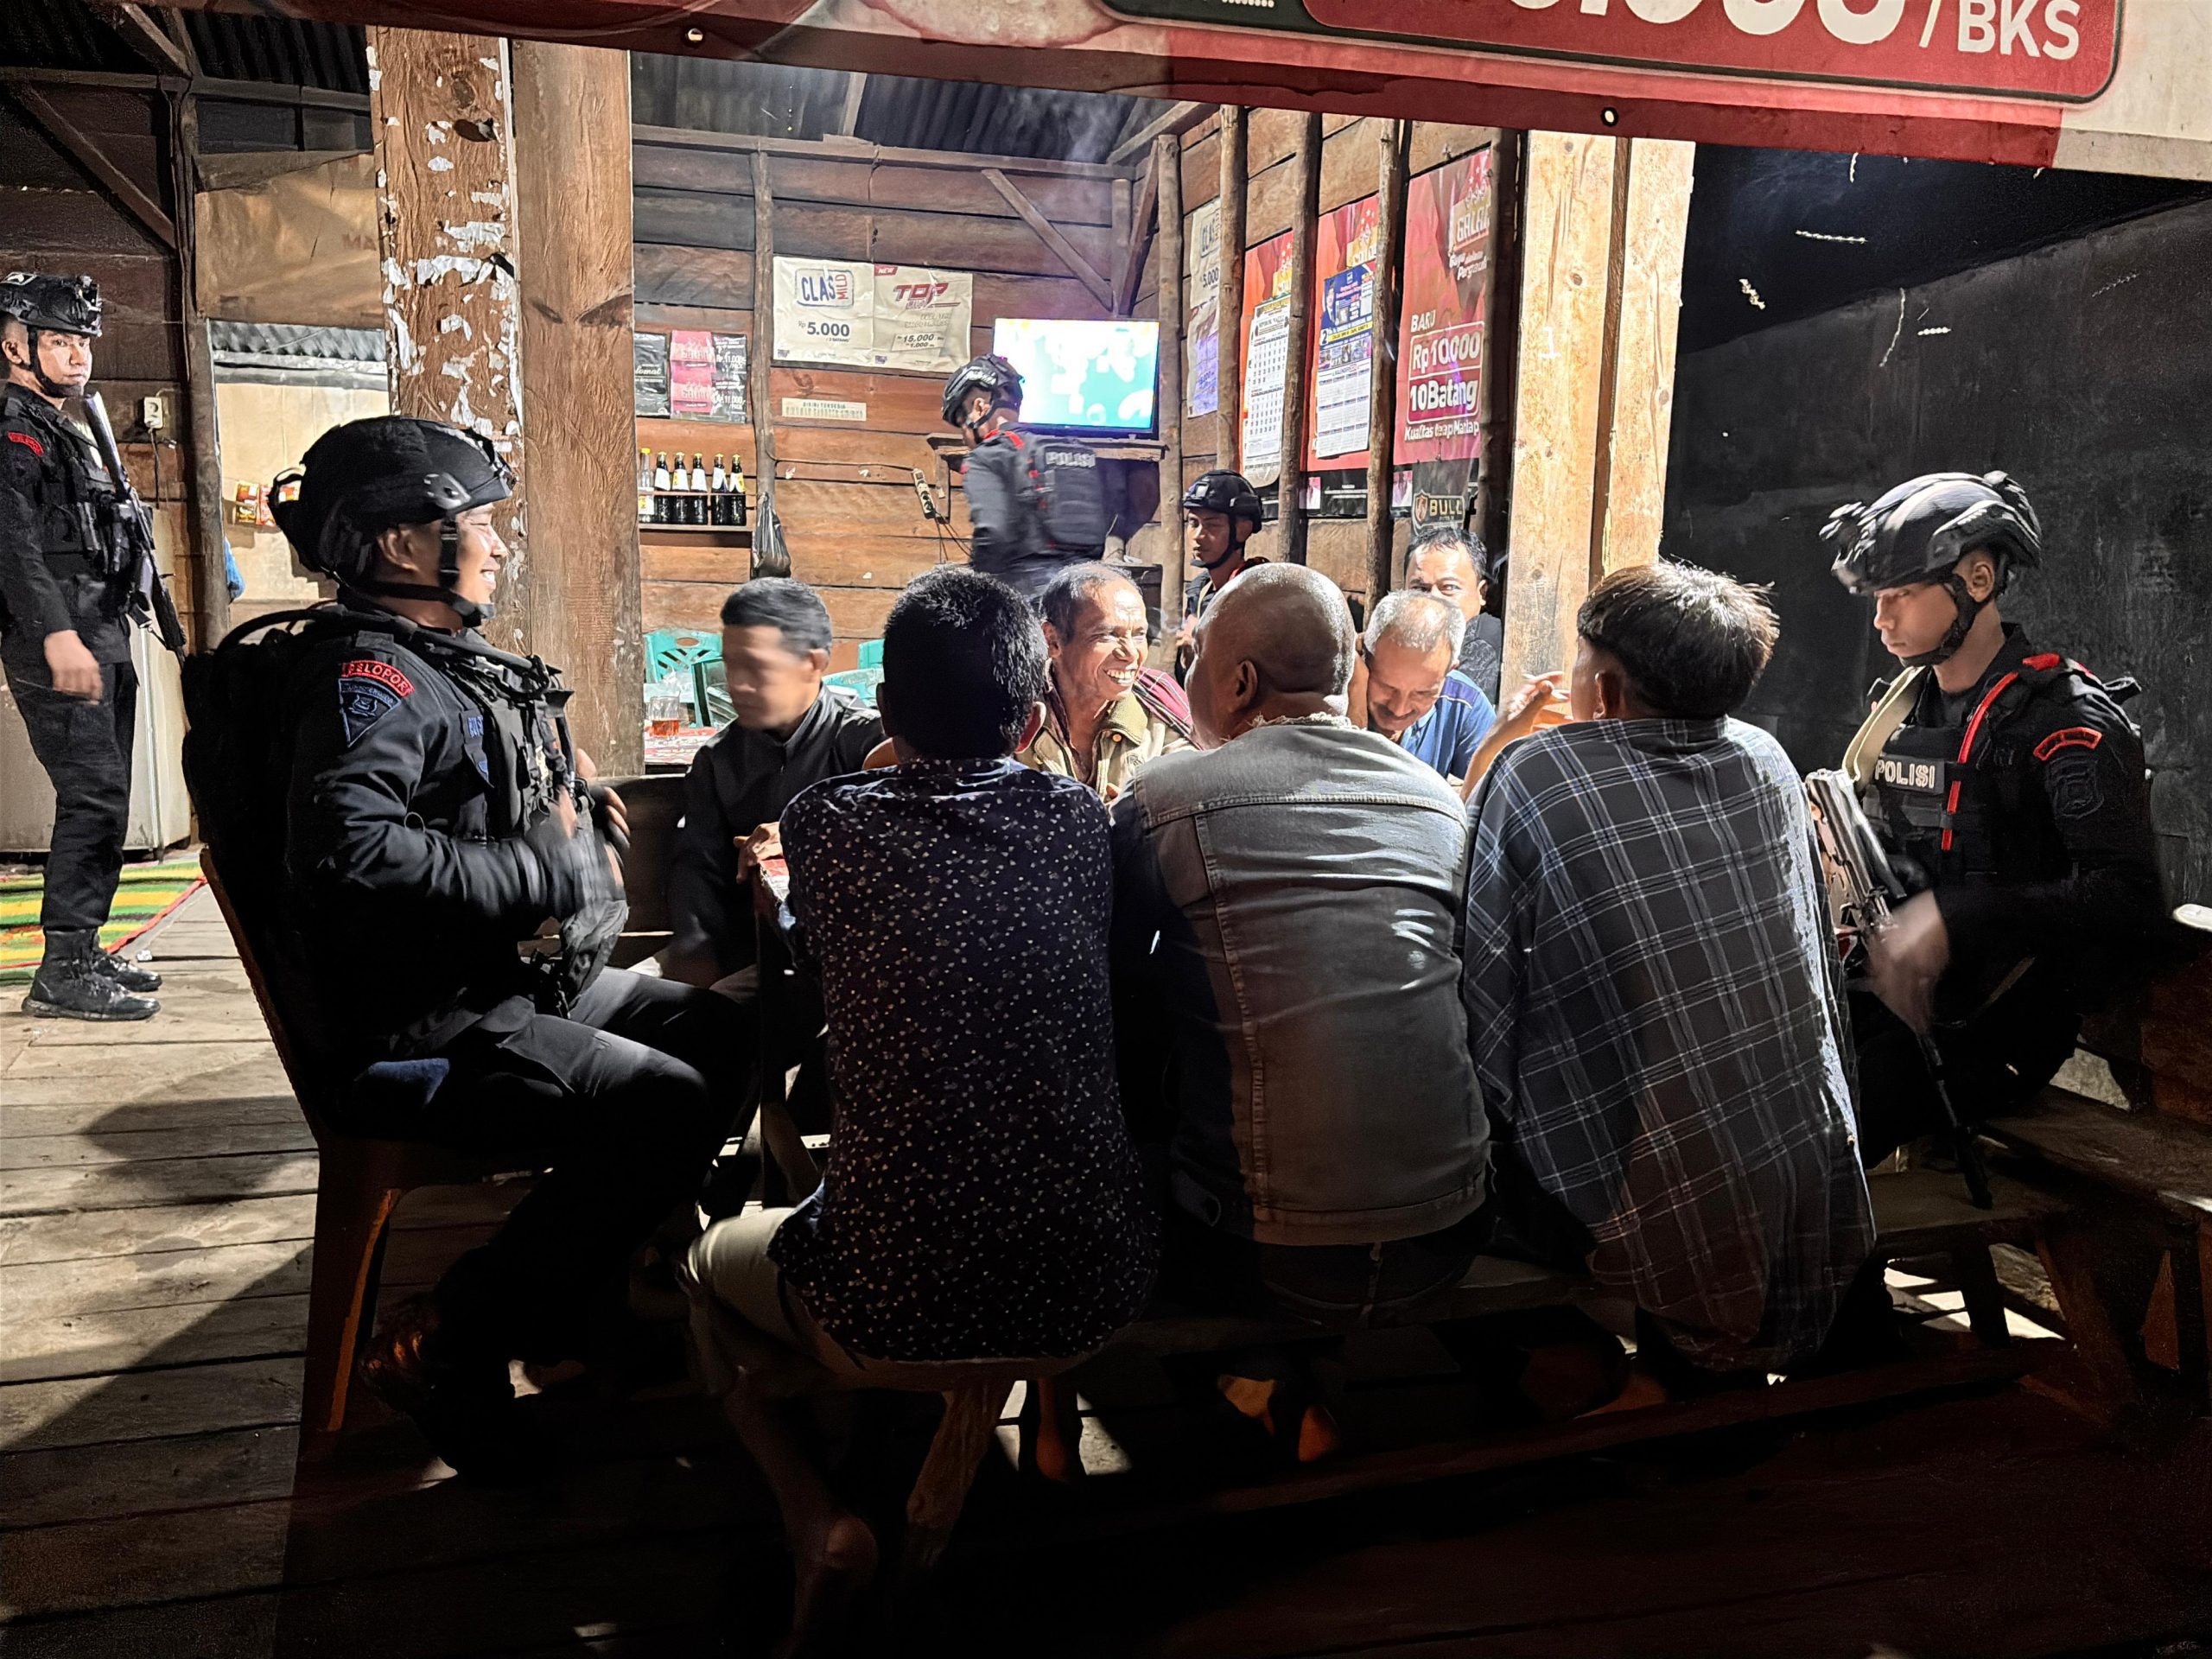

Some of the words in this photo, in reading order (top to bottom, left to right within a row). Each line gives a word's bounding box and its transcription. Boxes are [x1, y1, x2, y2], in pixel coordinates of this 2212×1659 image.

[802, 276, 836, 302] CLAS
[836, 274, 849, 300] MILD
[893, 283, 949, 305] TOP
[807, 321, 850, 337] 5.000
[1411, 309, 1436, 332] BARU
[1322, 330, 1327, 344] 2
[1430, 499, 1462, 516] BULL
[1874, 759, 1935, 789] POLISI
